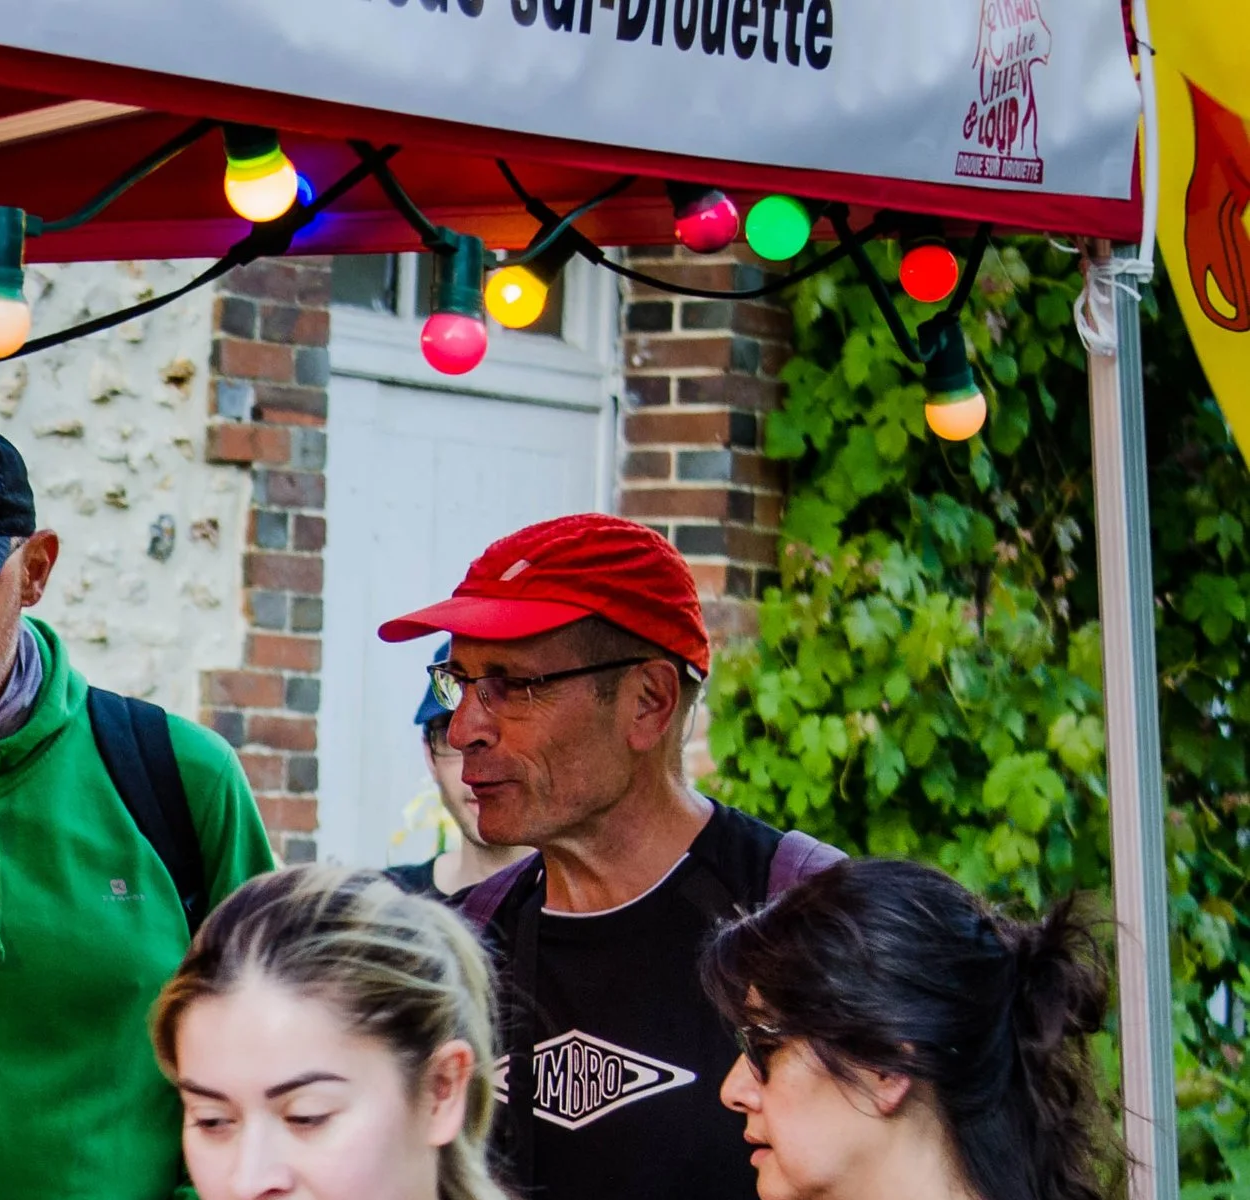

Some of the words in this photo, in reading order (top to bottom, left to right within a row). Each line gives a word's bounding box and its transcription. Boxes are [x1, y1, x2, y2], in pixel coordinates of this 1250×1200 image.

[980, 47, 1028, 106] CHIEN
[963, 101, 978, 140] &
[978, 97, 1019, 157] LOUP
